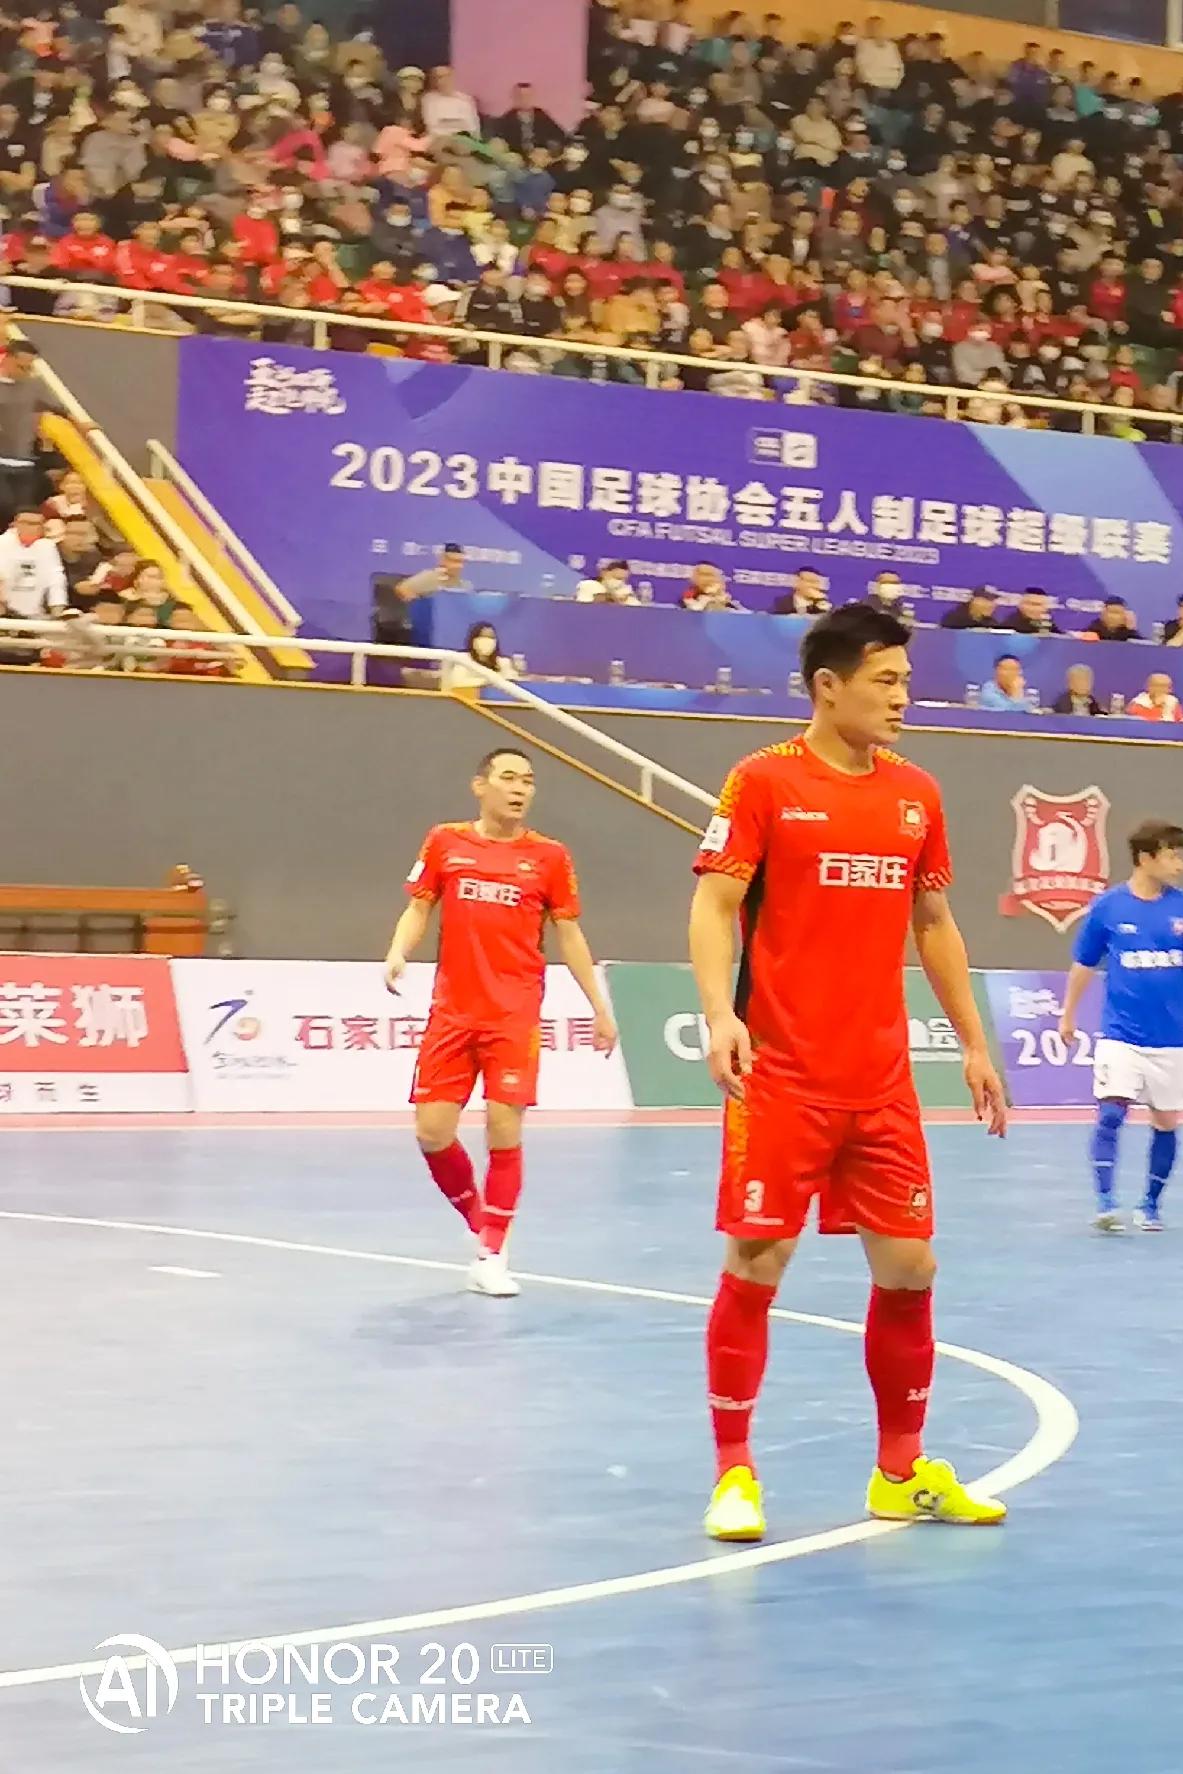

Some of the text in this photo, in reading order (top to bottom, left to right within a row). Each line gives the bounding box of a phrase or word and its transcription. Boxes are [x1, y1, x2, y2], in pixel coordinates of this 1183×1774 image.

[818, 852, 908, 889] 石家庄
[744, 1180, 764, 1212] 3
